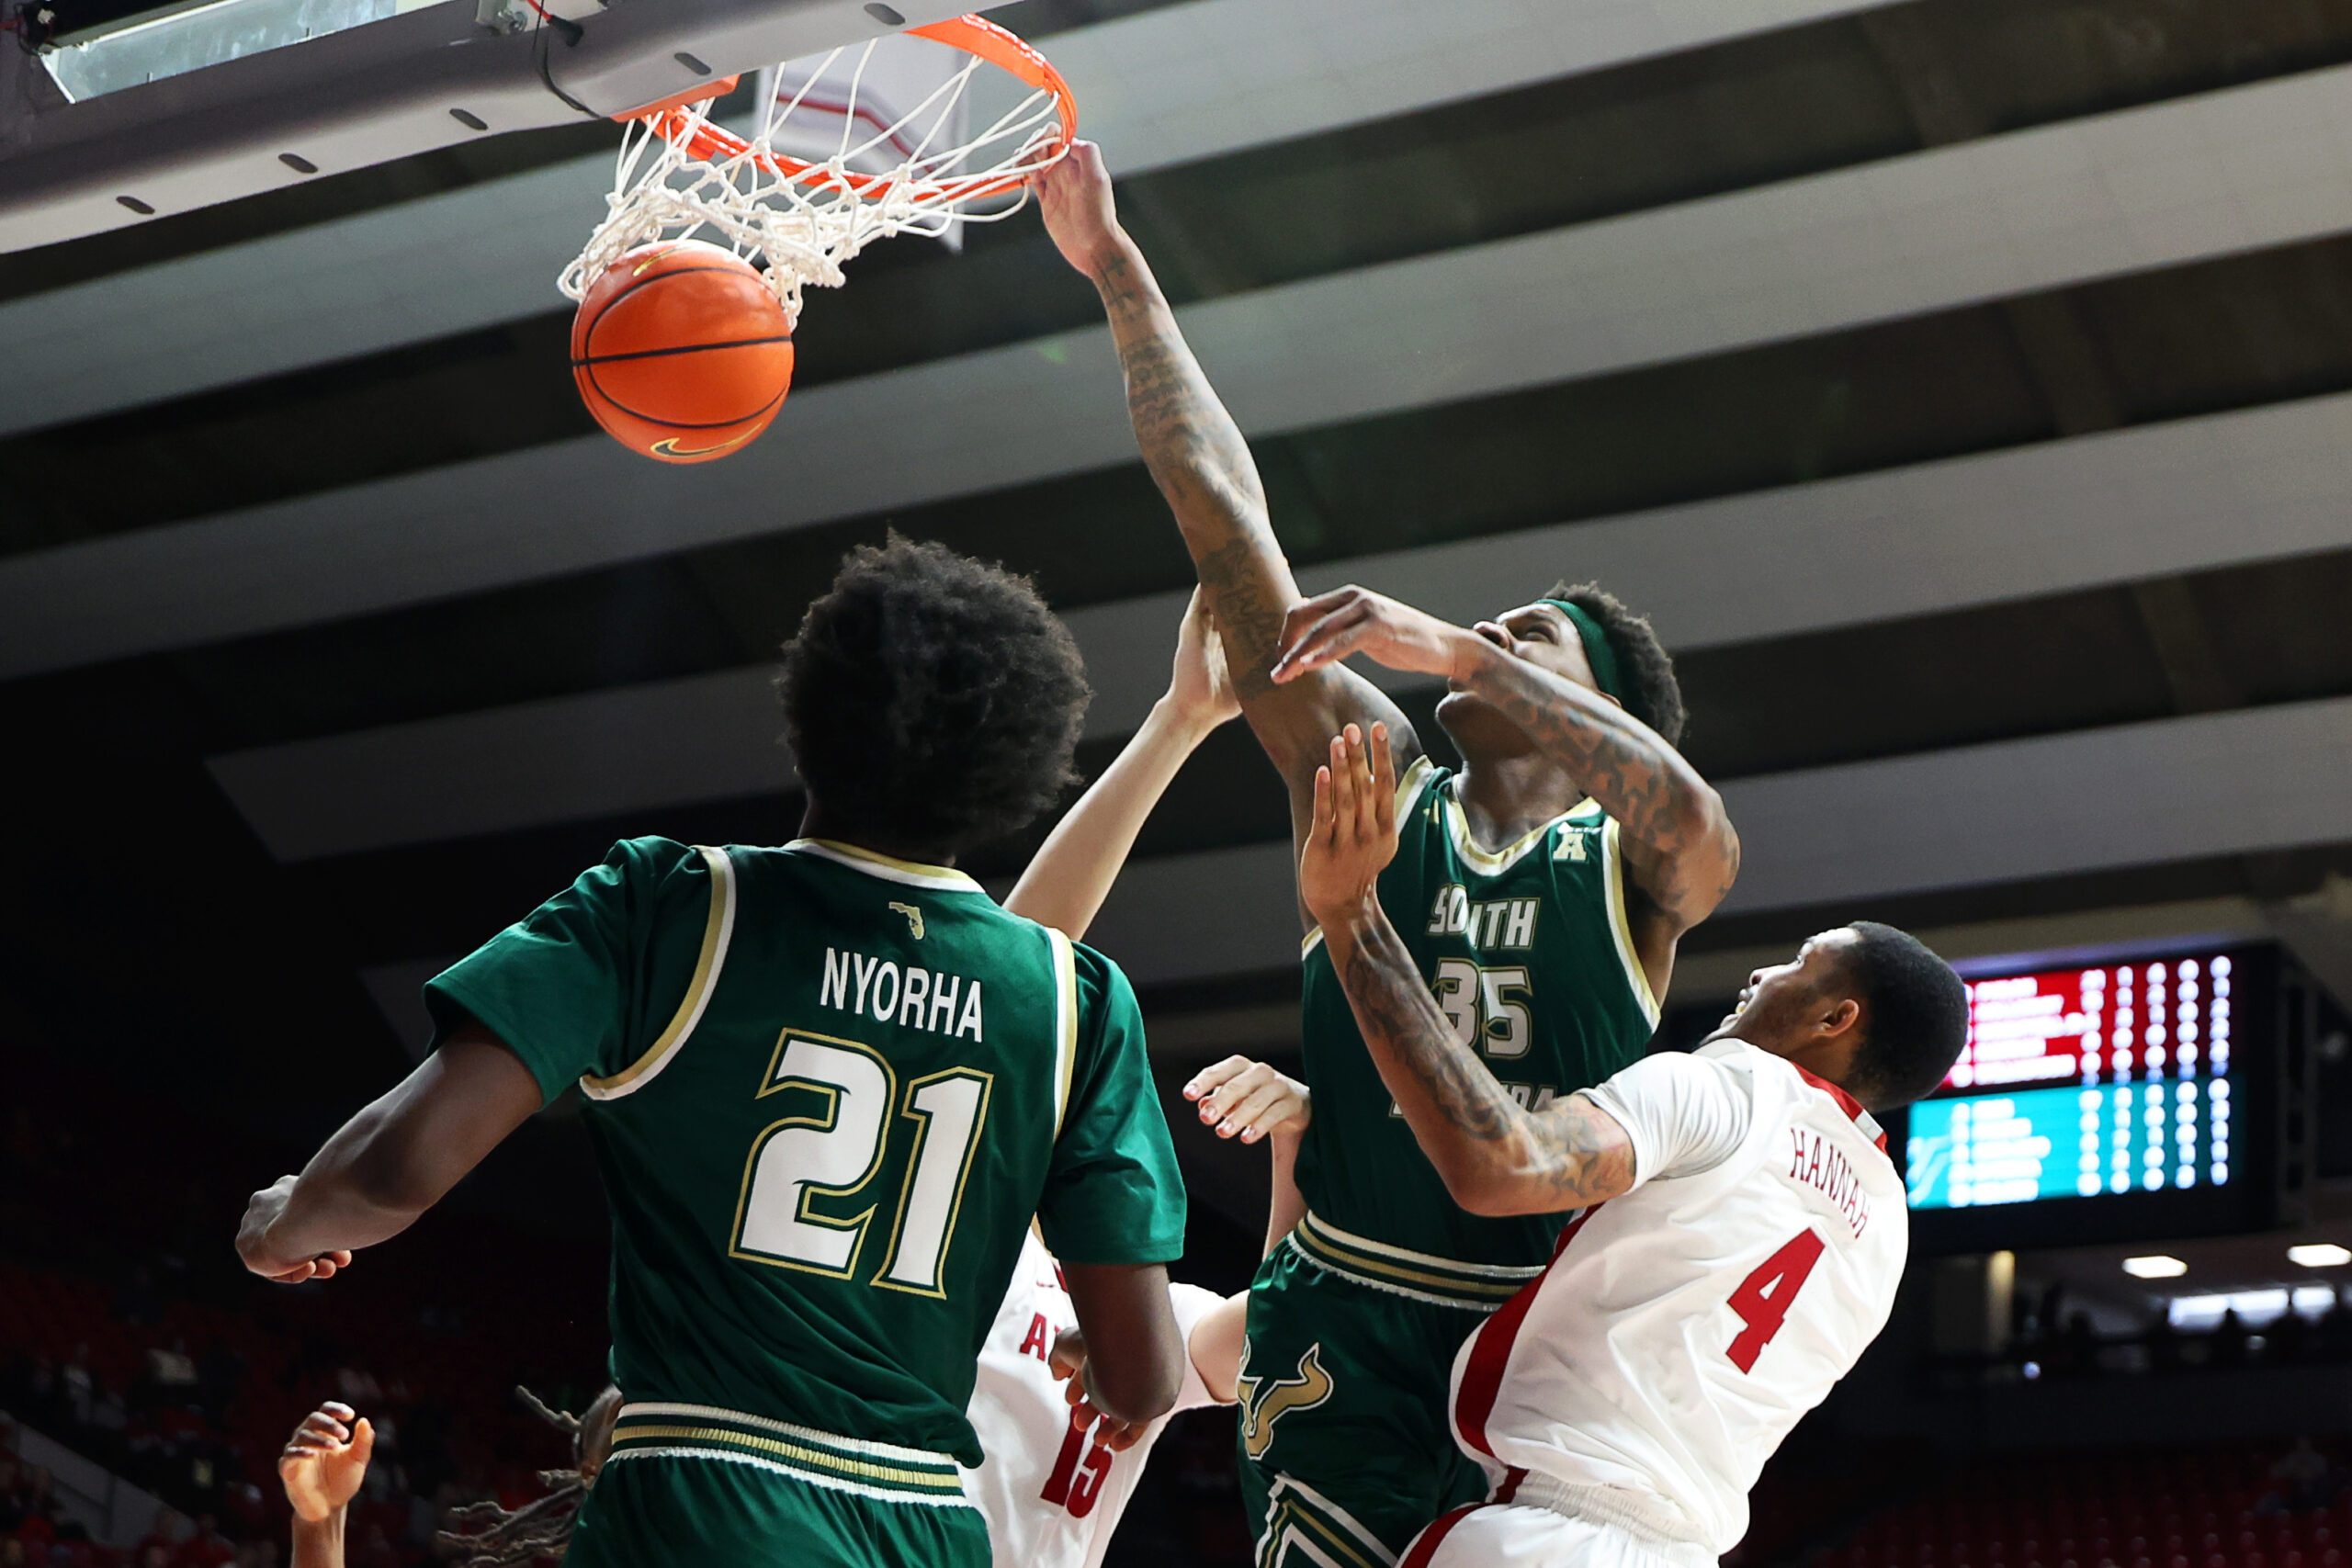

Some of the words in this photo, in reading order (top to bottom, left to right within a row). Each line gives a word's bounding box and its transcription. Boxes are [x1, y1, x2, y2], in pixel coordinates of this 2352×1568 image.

[820, 947, 983, 1043] NYORHA
[1430, 958, 1532, 1059] 35
[728, 1027, 994, 1301] 21
[1789, 1127, 1871, 1240] HANNAH
[1725, 1227, 1826, 1375] 4
